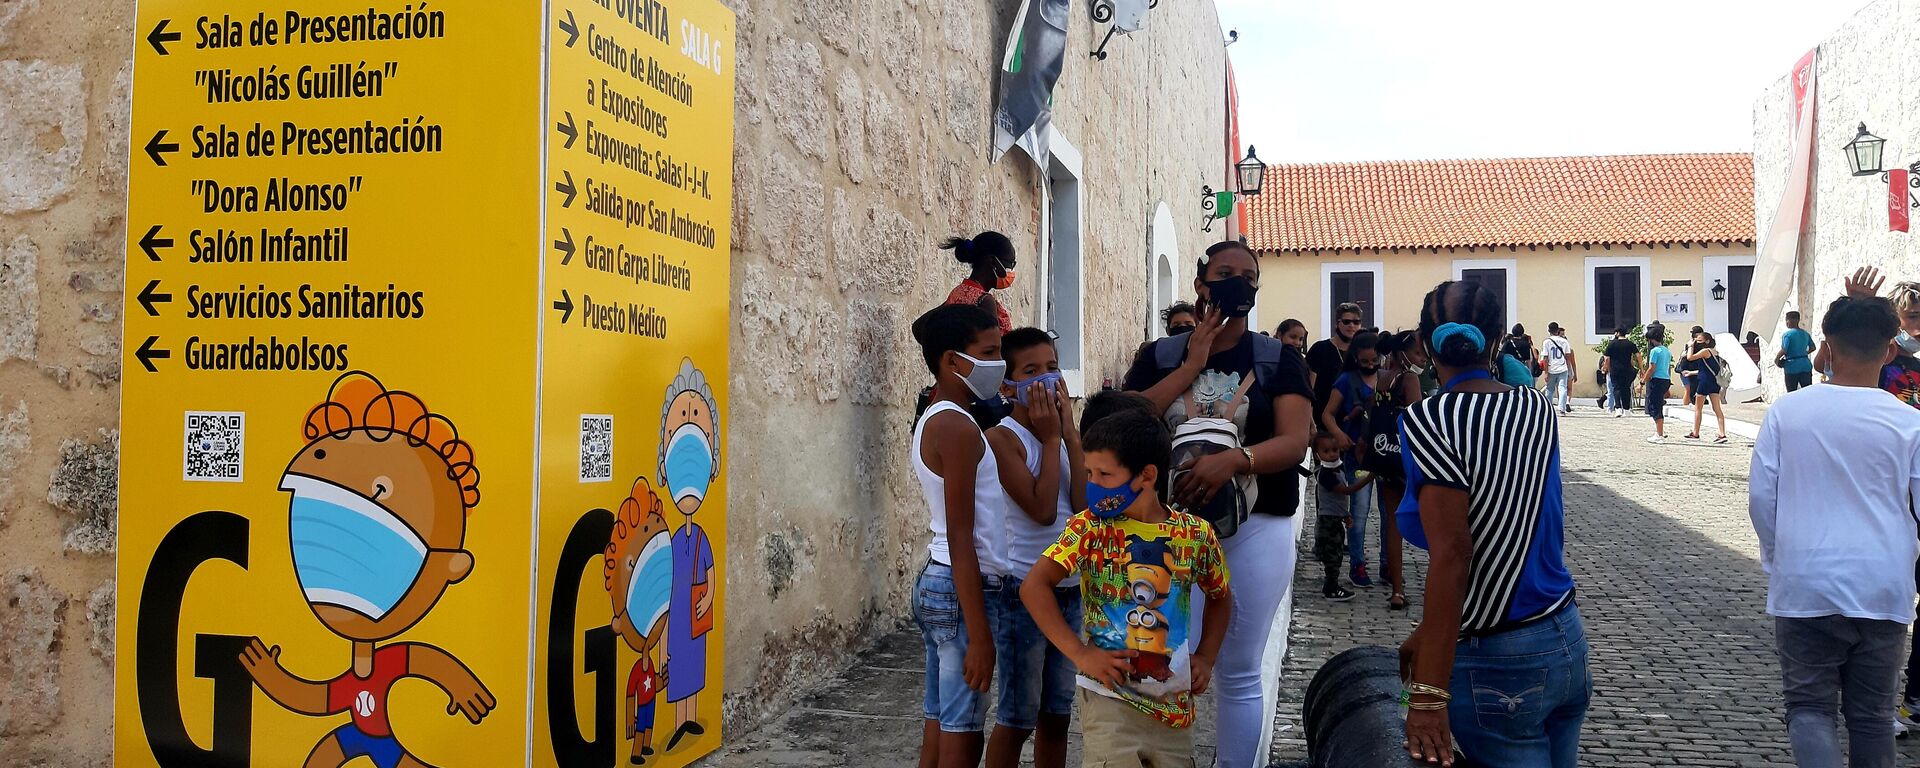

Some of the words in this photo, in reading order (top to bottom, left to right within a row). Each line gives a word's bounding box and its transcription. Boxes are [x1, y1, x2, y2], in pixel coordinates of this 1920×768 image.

[195, 15, 243, 50] Sala
[249, 12, 279, 47] de
[285, 2, 445, 45] Presentación
[593, 0, 669, 46] OVENTA
[681, 18, 711, 70] SALA
[713, 39, 721, 75] G
[195, 64, 290, 103] "Nicolás
[296, 61, 398, 99] Guillén"
[587, 23, 627, 73] Centro
[630, 48, 644, 82] de
[647, 56, 692, 108] Atención
[587, 79, 595, 106] a
[602, 78, 668, 139] Expositores
[191, 124, 239, 158] Sala
[246, 122, 275, 157] de
[281, 115, 442, 155] Presentación
[587, 120, 652, 176] Expoventa:
[656, 150, 682, 189] Salas
[191, 179, 258, 213] "Dora
[264, 175, 363, 212] Alonso"
[585, 178, 623, 221] Salida
[626, 198, 646, 228] por
[648, 200, 667, 234] San
[670, 208, 715, 249] Ambrosio
[189, 229, 253, 263] Salón
[260, 227, 348, 262] Infantil
[585, 235, 614, 273] Gran
[618, 244, 649, 284] Carpa
[652, 253, 691, 292] Librería
[187, 285, 291, 319] Servicios
[298, 283, 424, 318] Sanitarios
[583, 294, 625, 333] Puesto
[628, 303, 667, 340] Médico
[185, 336, 349, 371] Guardabolsos
[1550, 346, 1564, 360] 10
[136, 510, 253, 768] G
[547, 508, 617, 768] G
